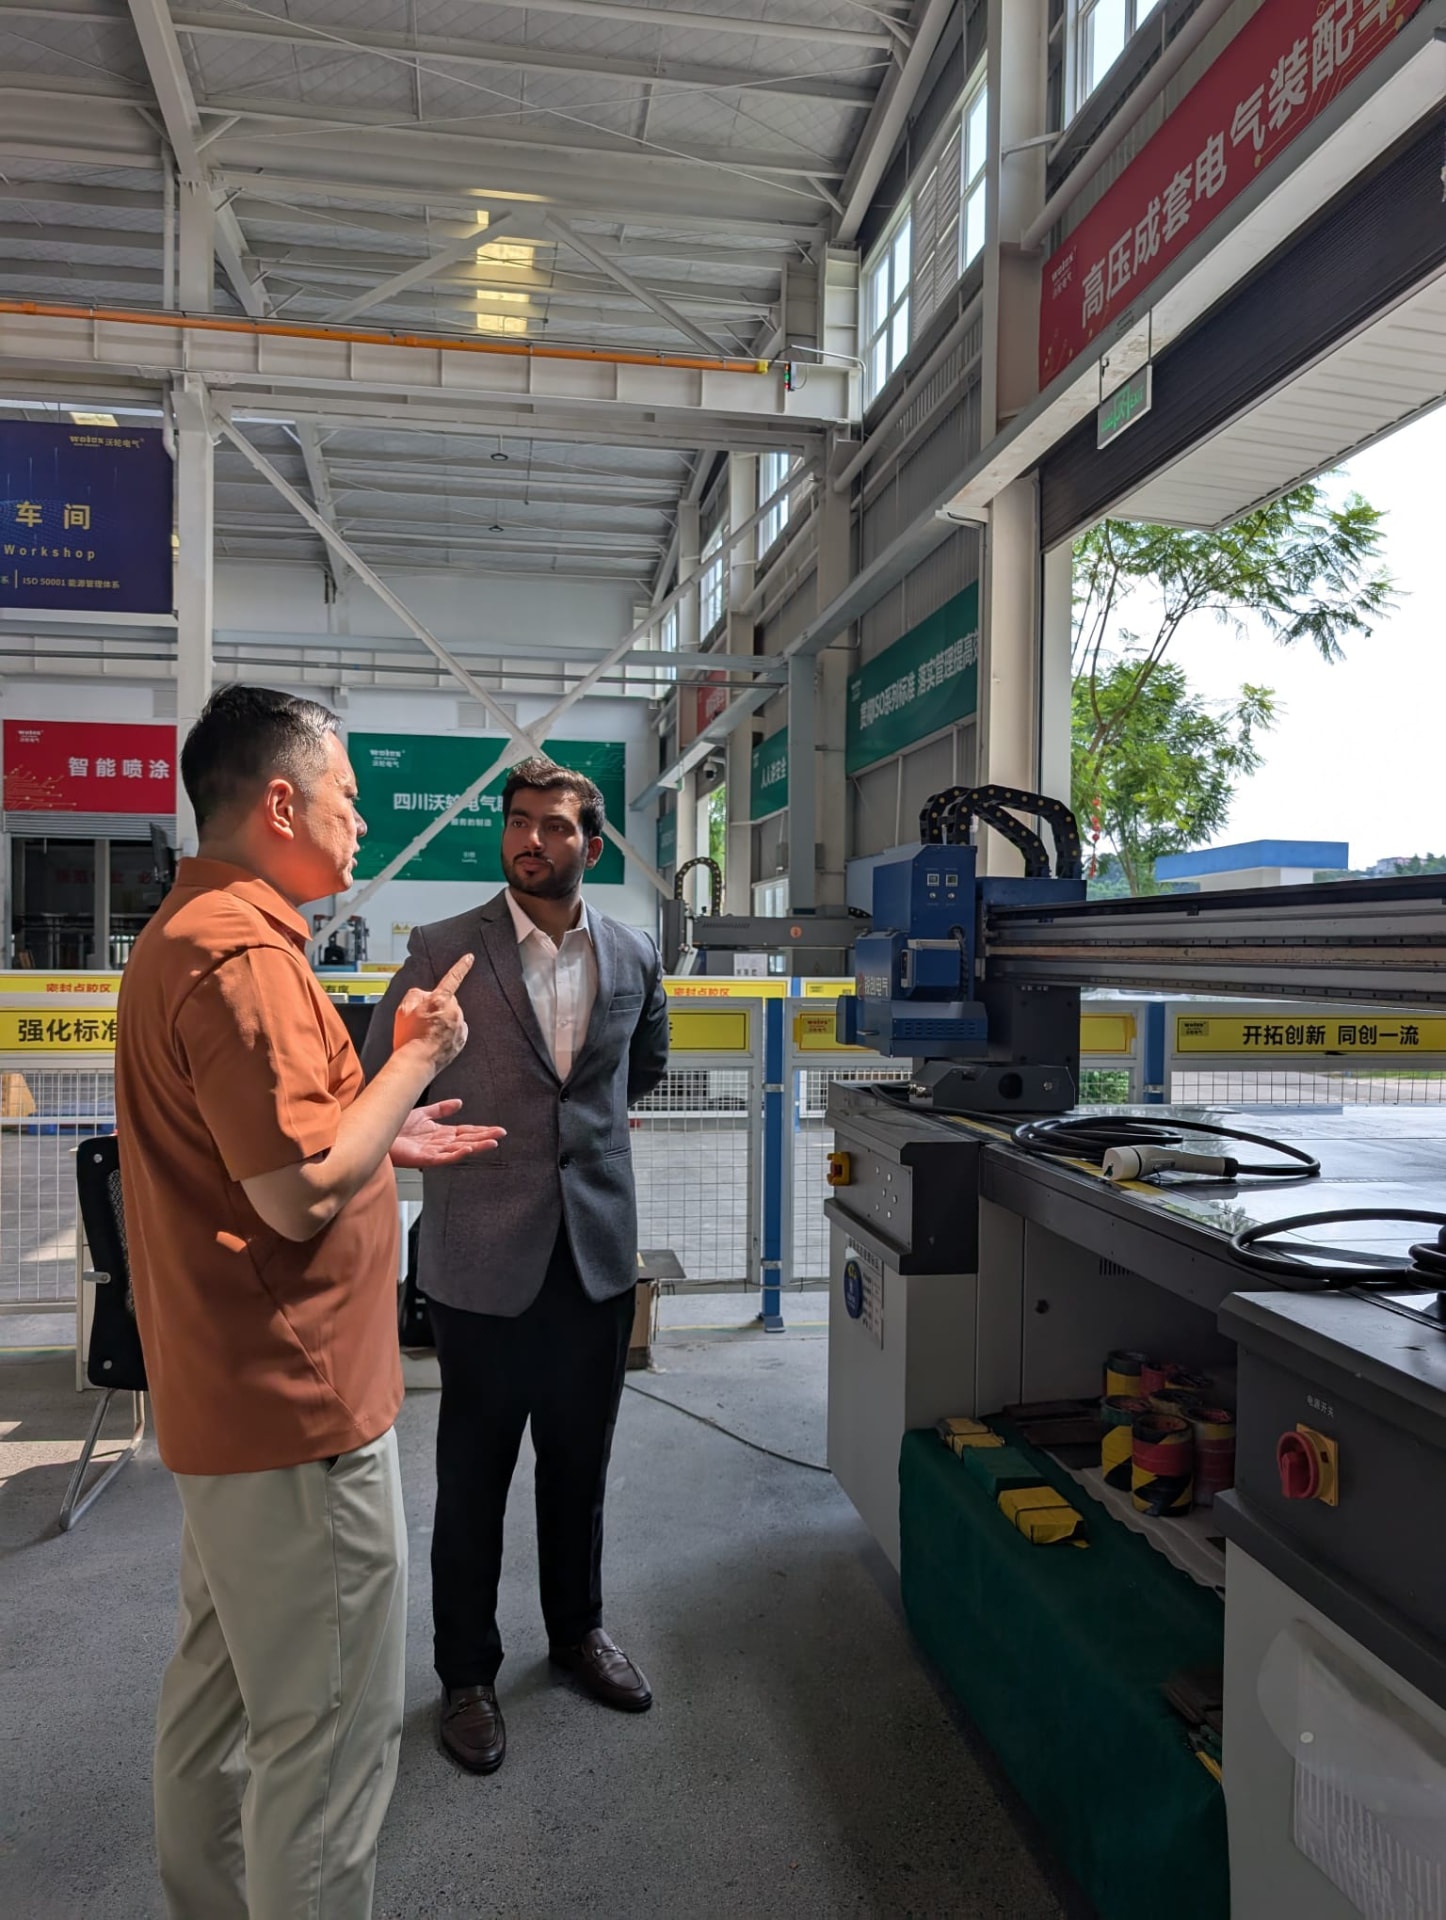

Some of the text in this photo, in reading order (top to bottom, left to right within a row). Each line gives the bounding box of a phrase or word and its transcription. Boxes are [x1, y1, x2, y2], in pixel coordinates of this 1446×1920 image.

[15, 501, 91, 530] 车间
[4, 544, 95, 561] Workshop
[23, 577, 38, 585] ISO
[40, 578, 65, 586] 50001
[68, 756, 170, 779] 智能喷涂
[46, 983, 112, 993] 密封点胶区
[674, 987, 730, 997] 密封点胶区
[18, 1019, 118, 1042] 强化标准
[1243, 1025, 1419, 1046] 开拓创新 同创一流
